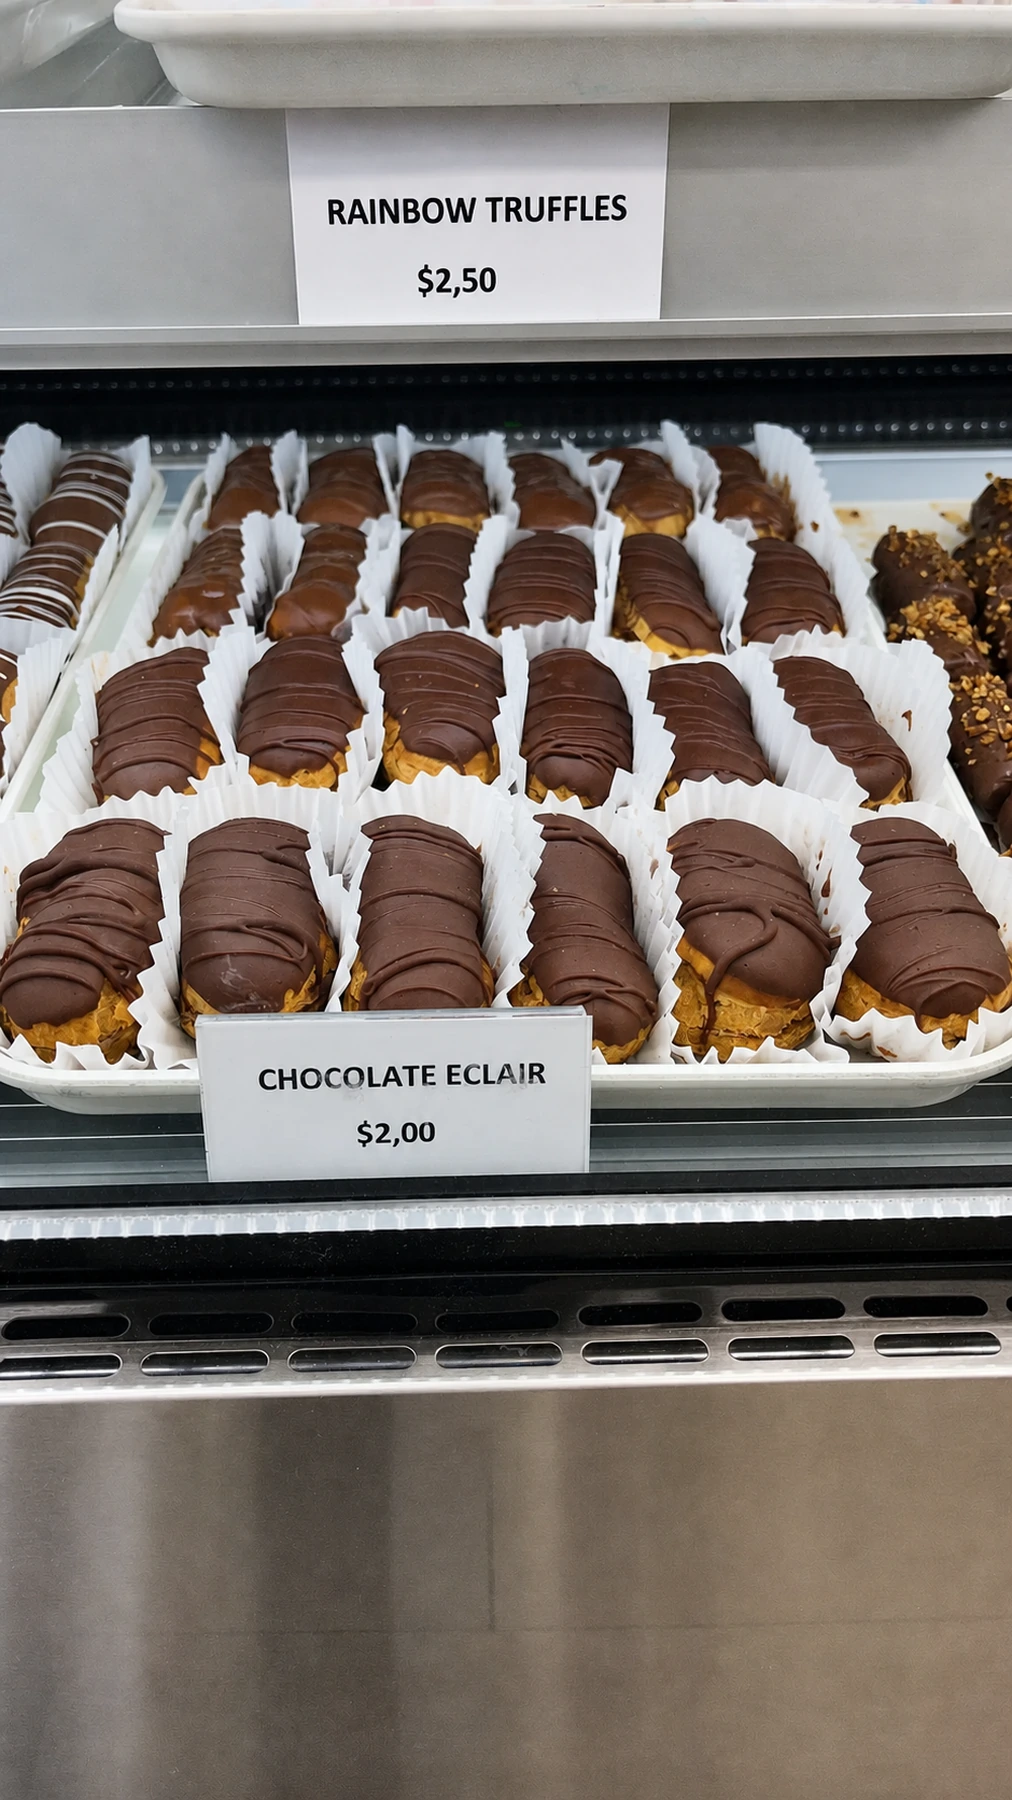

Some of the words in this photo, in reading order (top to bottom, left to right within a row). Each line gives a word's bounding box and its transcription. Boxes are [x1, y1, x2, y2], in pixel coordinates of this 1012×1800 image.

[327, 196, 477, 226] RAINBOW
[484, 194, 628, 223] TRUFFLES
[417, 263, 497, 299] $2,50
[259, 1065, 438, 1092] CHOCOLATE
[447, 1063, 547, 1087] ECLAIR
[358, 1121, 437, 1149] $2,00
